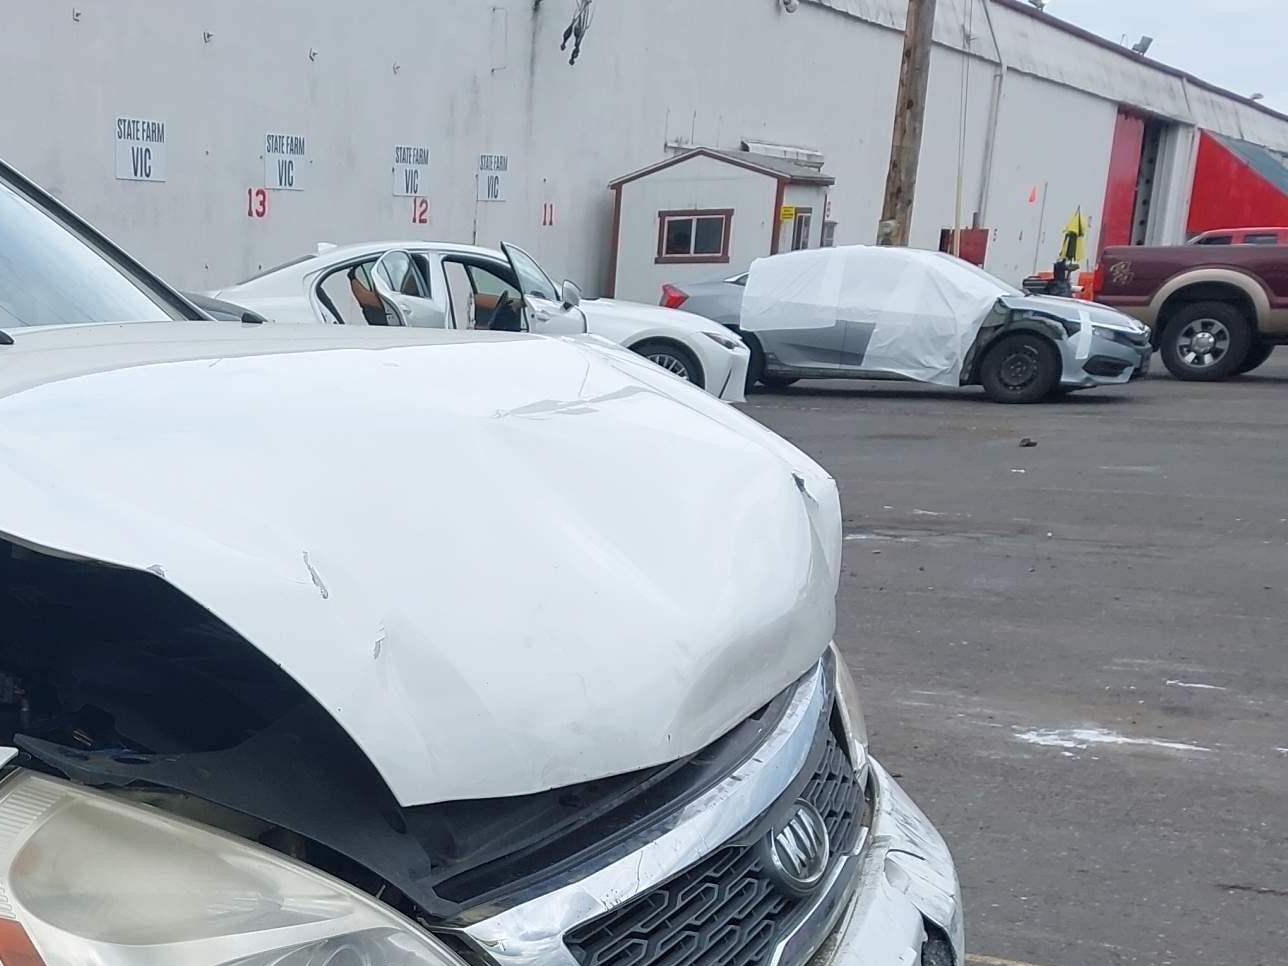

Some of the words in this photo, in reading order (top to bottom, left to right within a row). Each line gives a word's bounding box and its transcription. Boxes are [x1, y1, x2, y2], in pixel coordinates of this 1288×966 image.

[117, 118, 141, 141] STATE
[142, 121, 165, 143] FARM
[266, 134, 285, 154] STATE
[286, 136, 305, 155] FARM
[395, 146, 412, 164] STATE
[413, 148, 429, 165] FARM
[131, 146, 151, 178] VIC
[277, 159, 294, 187] VIC
[405, 169, 419, 194] VIC
[487, 175, 500, 199] VIC
[247, 187, 266, 217] 13
[412, 197, 429, 224] 12
[542, 203, 553, 226] 11
